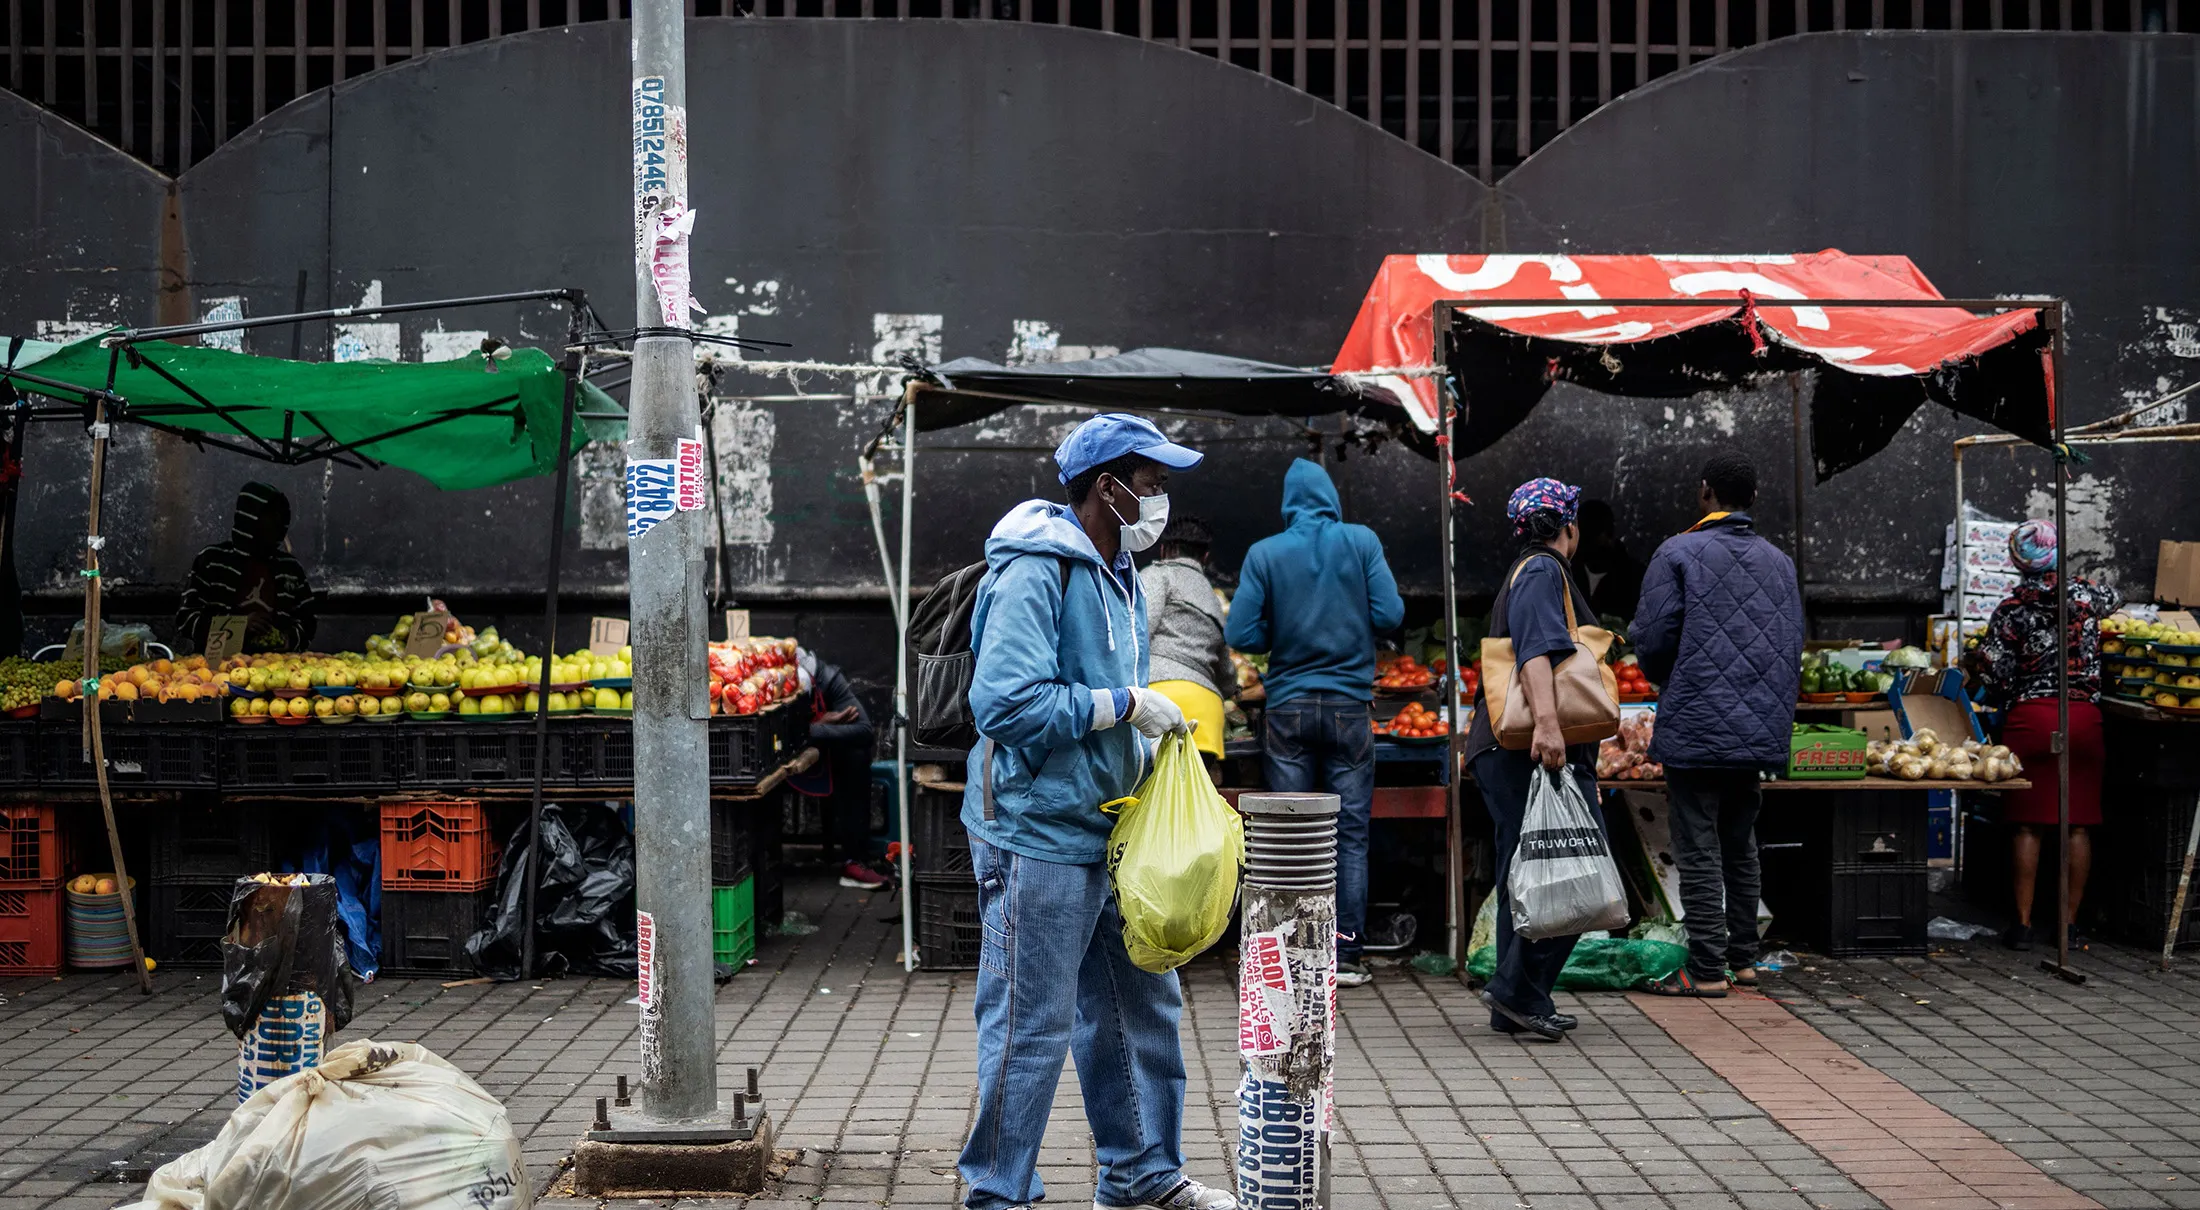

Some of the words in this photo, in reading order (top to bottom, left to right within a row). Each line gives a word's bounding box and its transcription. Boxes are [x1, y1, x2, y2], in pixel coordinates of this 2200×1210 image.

[636, 464, 675, 512] 8422
[680, 442, 695, 511] ORTION
[1795, 749, 1865, 766] FRESH
[640, 914, 652, 1005] ABORTION
[1249, 937, 1263, 983] SONAR
[1249, 990, 1261, 1023] DAY
[1239, 1125, 1261, 1171] 268
[1303, 1130, 1315, 1210] MINUTE
[1239, 1173, 1261, 1210] 65
